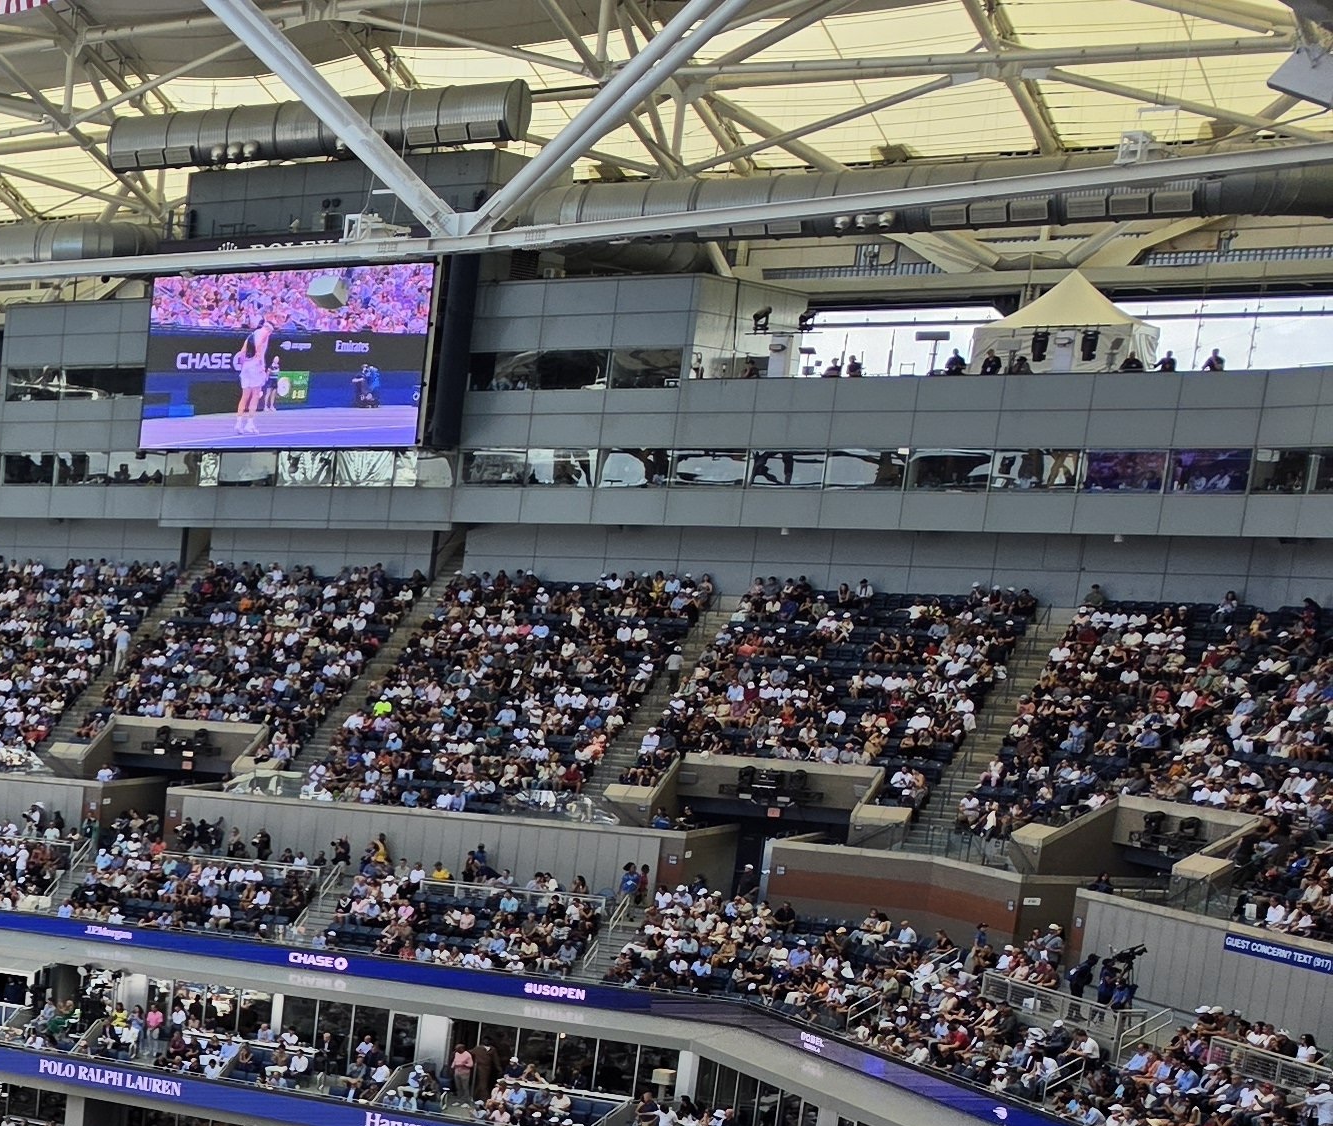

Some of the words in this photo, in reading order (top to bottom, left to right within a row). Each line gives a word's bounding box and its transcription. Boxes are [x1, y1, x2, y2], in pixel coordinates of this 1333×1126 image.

[335, 340, 370, 353] Emirates
[176, 352, 232, 370] CHASE
[289, 952, 335, 968] CHASE
[1225, 936, 1251, 950] GUEST
[1251, 942, 1293, 960] CONCERN?
[1293, 951, 1313, 964] TEXT
[1313, 957, 1332, 971] (917)
[523, 982, 586, 1001] #USOPEN
[39, 1059, 75, 1078] POLO
[77, 1065, 124, 1087] RALPH
[125, 1073, 182, 1097] LAUREN
